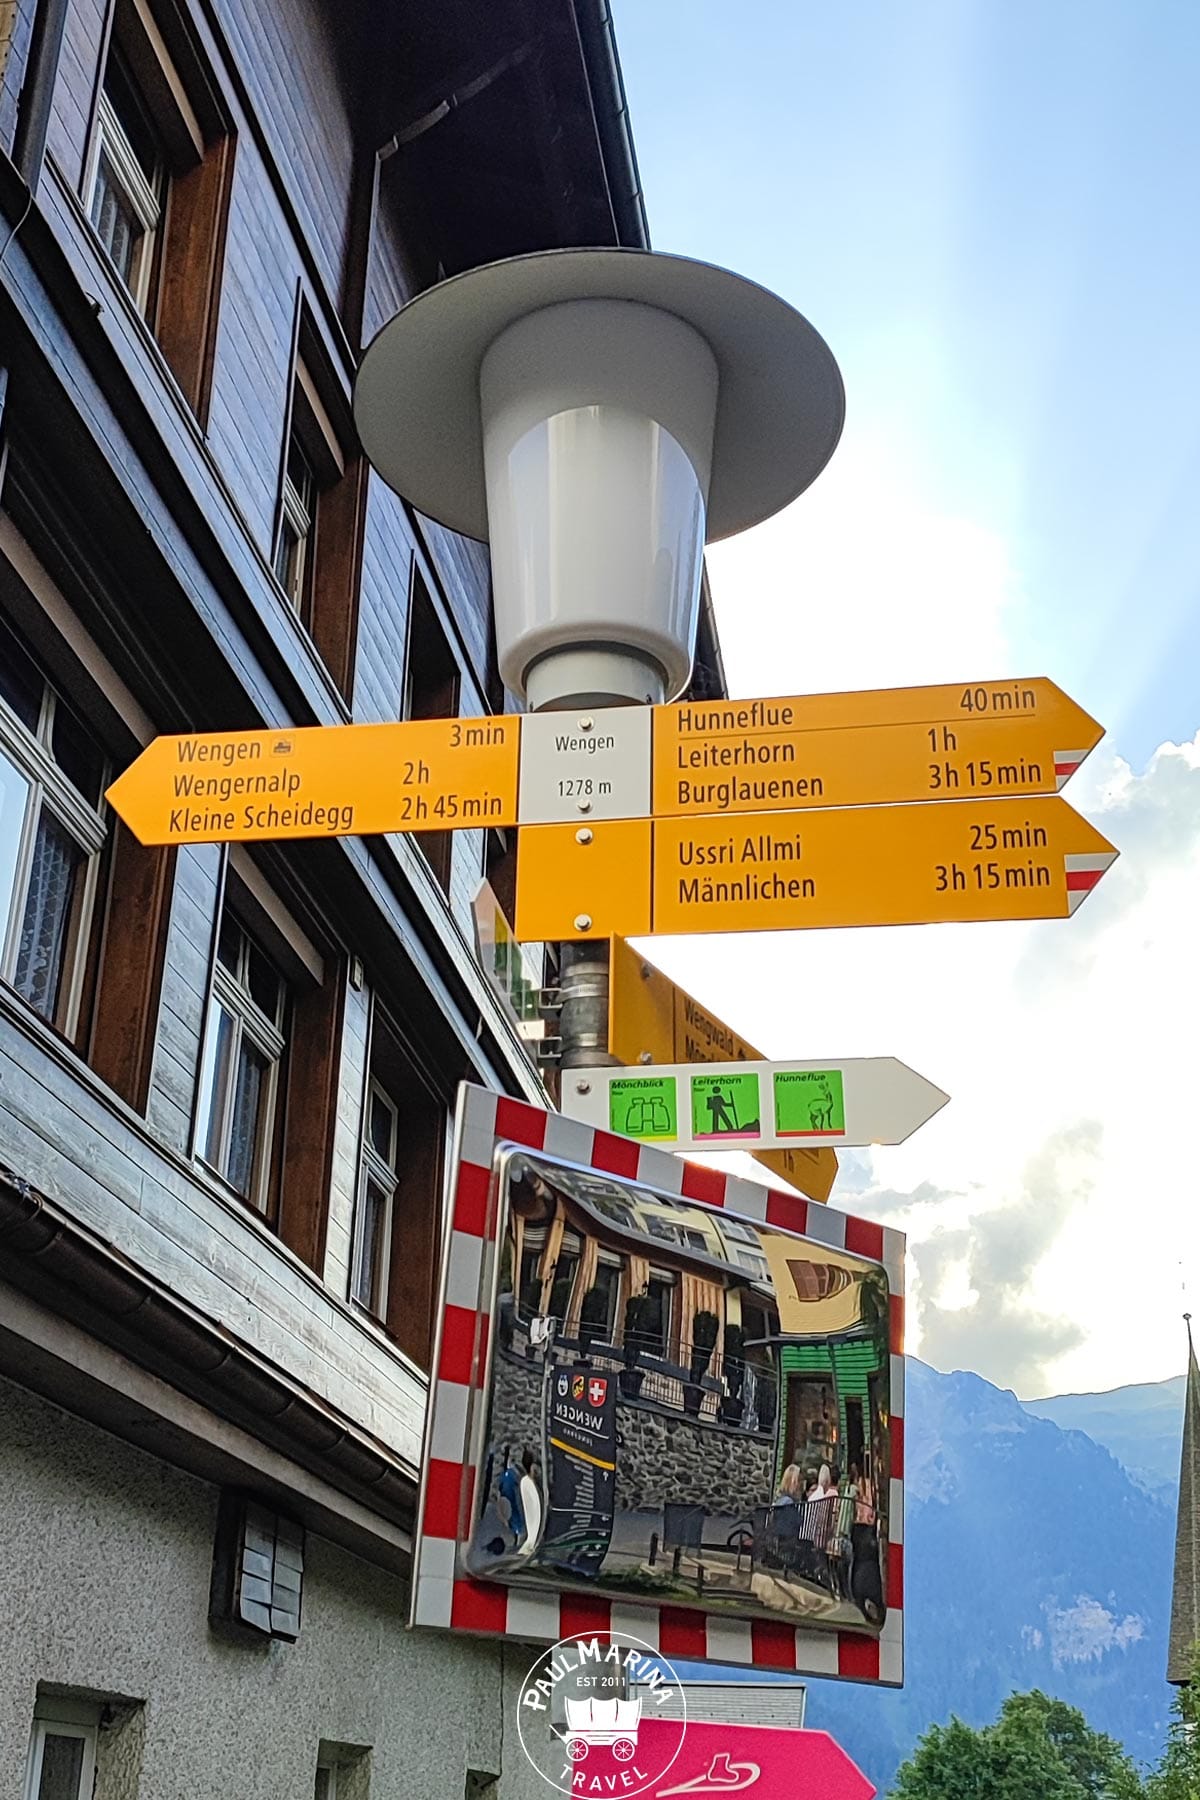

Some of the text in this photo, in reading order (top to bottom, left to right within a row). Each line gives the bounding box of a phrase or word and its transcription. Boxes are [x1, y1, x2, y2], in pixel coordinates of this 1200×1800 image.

[678, 702, 793, 732] Hunneflue
[177, 739, 261, 767] Wengen
[555, 735, 614, 754] Wengen
[678, 741, 795, 769] Leiterhorn
[173, 768, 301, 801] Wengernalp
[558, 779, 612, 797] 1278 m
[678, 776, 824, 809] Burglauenen
[169, 801, 354, 833] Kleine Scheidegg
[679, 834, 801, 865] Ussri Allmi
[679, 872, 816, 904] Männlichen
[683, 995, 734, 1057] Wengwald
[611, 1079, 664, 1089] Mönchblick
[692, 1076, 742, 1087] Leiterhorn
[775, 1073, 826, 1083] Hunneflue
